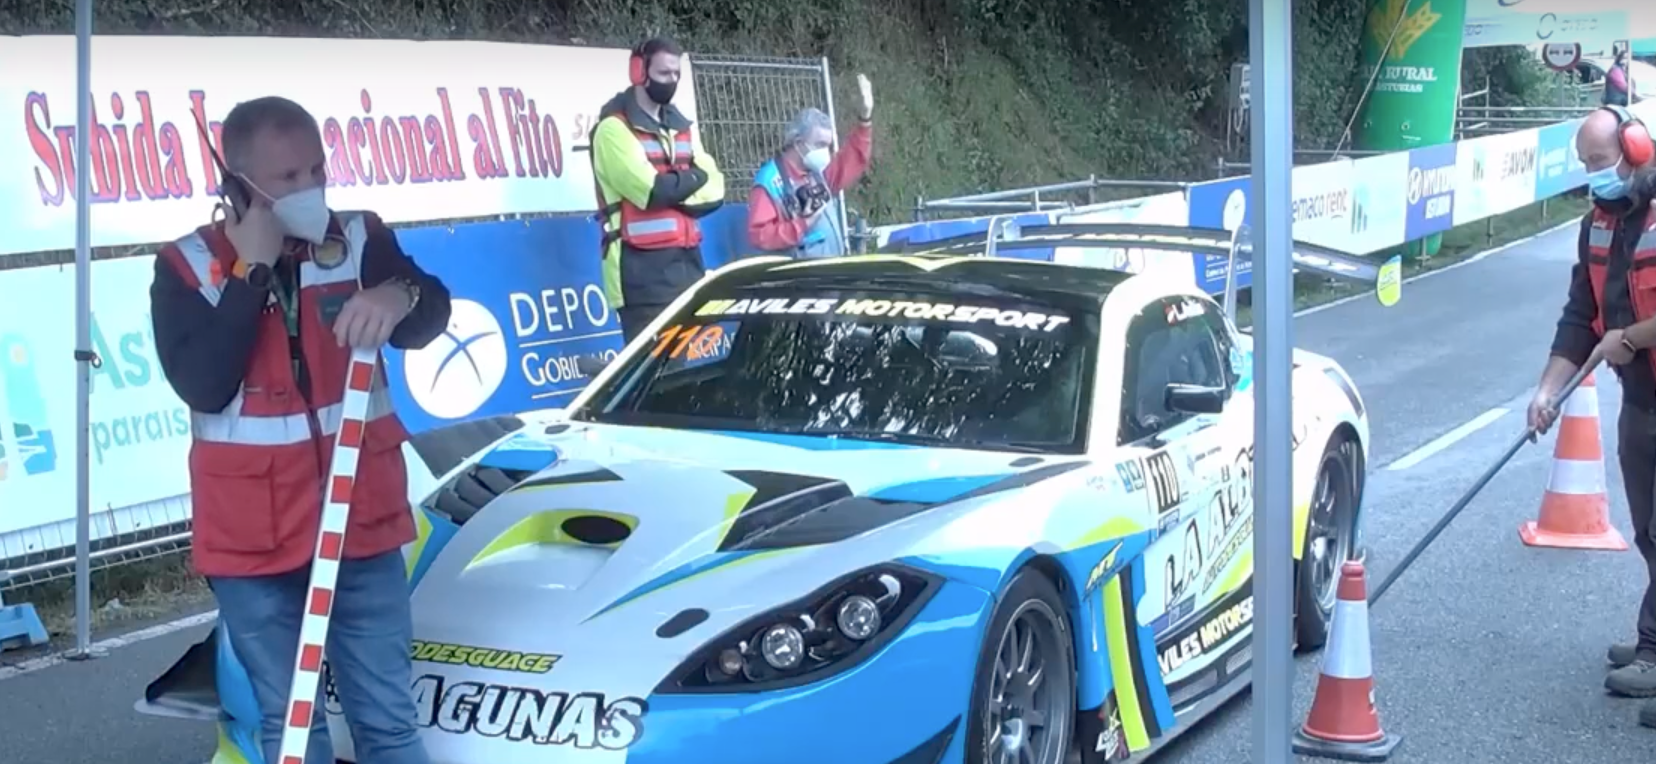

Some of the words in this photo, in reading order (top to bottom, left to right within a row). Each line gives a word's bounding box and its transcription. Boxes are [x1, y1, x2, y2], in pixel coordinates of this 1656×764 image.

[1385, 66, 1438, 81] RURAL
[24, 91, 191, 206] Subida
[189, 88, 465, 196] Iacional
[467, 87, 508, 179] al
[499, 87, 563, 179] Fito
[1506, 145, 1536, 178] AVON
[1292, 194, 1325, 223] emaco
[509, 283, 622, 338] DEPO
[724, 299, 832, 314] AVILES
[835, 299, 1071, 332] MOTORSPORT
[652, 324, 723, 361] 110
[89, 408, 189, 465] parais
[1146, 450, 1181, 513] 110
[411, 640, 557, 673] ODESGUACE
[1157, 632, 1202, 678] VILES
[1200, 601, 1254, 648] MOTORS
[411, 675, 648, 750] AGUNAS
